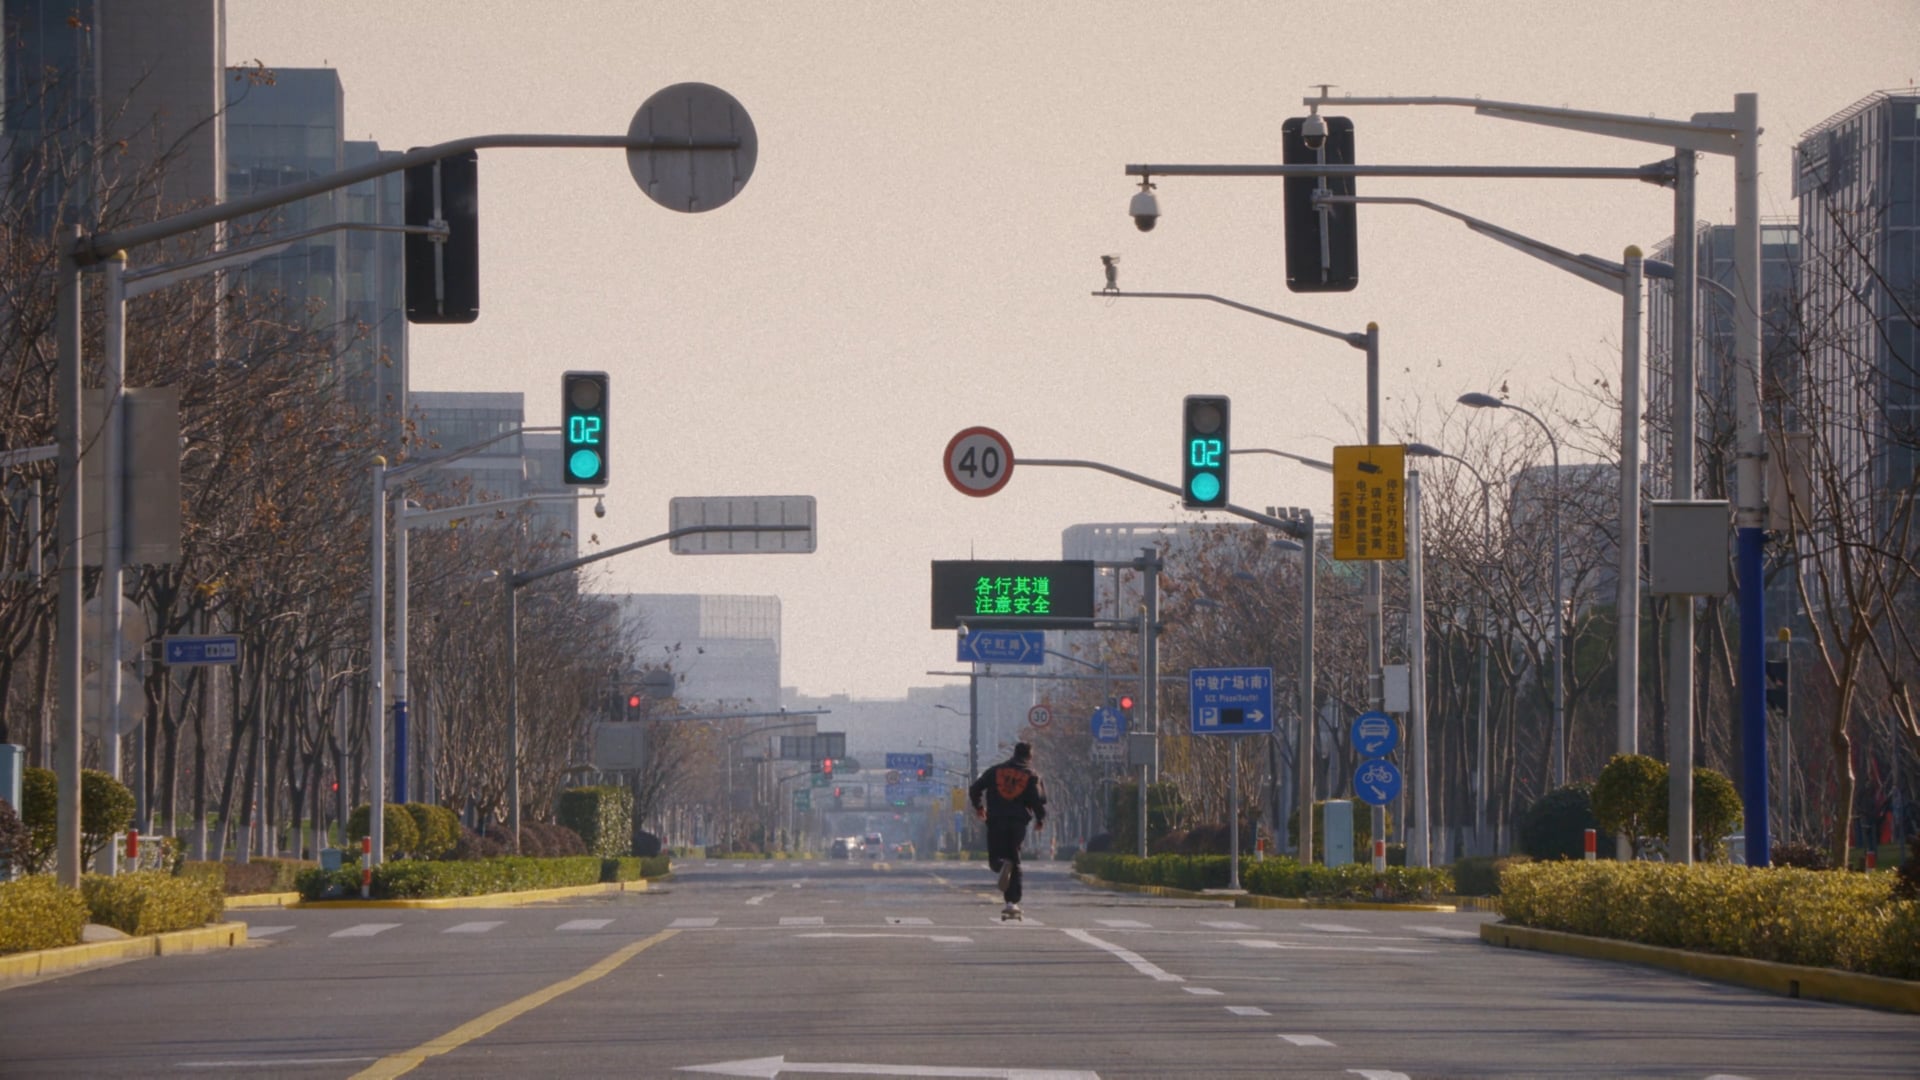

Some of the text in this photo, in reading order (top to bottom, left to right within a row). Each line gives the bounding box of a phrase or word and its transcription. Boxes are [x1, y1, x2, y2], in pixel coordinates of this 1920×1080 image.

[570, 416, 600, 443] 02
[958, 446, 999, 478] 40
[1191, 440, 1221, 466] 02
[975, 576, 1050, 595] 各行其道
[976, 595, 1050, 614] 注意安全
[1034, 710, 1048, 723] 30
